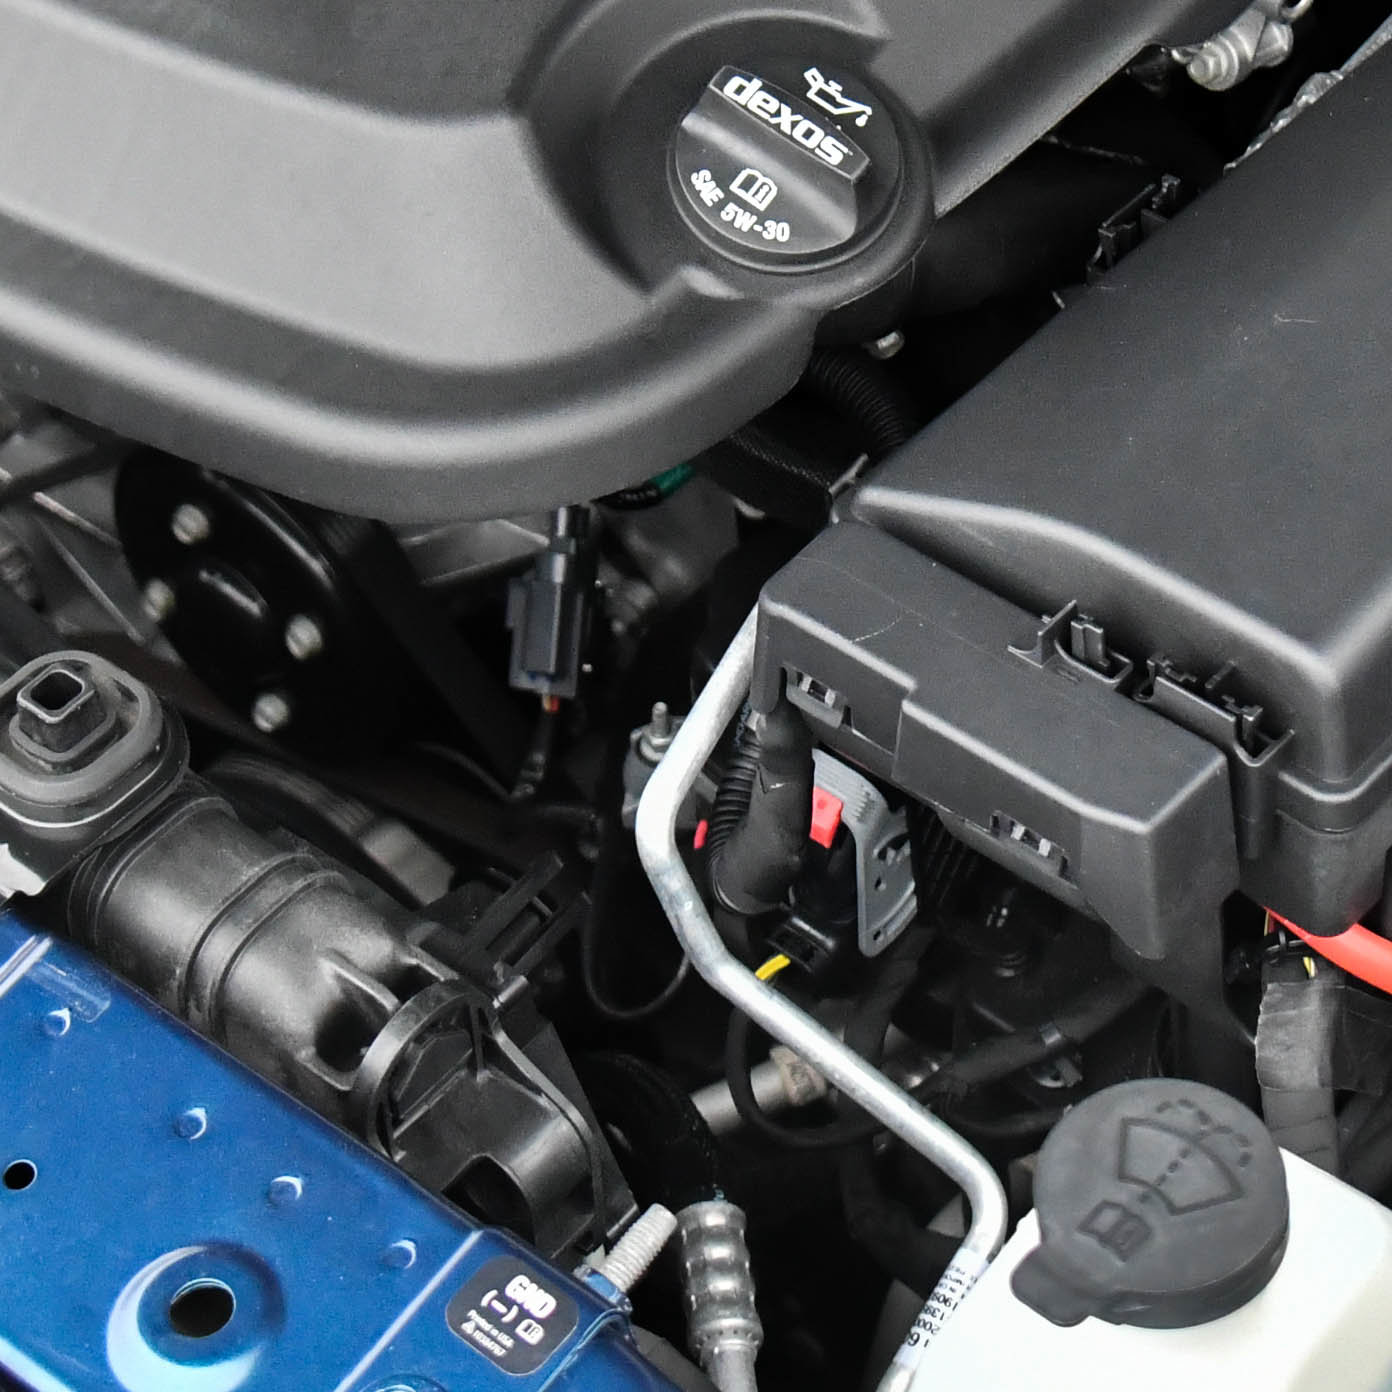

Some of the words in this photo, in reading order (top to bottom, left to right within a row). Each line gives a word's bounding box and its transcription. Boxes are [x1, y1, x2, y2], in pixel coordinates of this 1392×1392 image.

[723, 75, 850, 165] dexos
[691, 169, 724, 207] SAE
[720, 202, 790, 242] 5W-30
